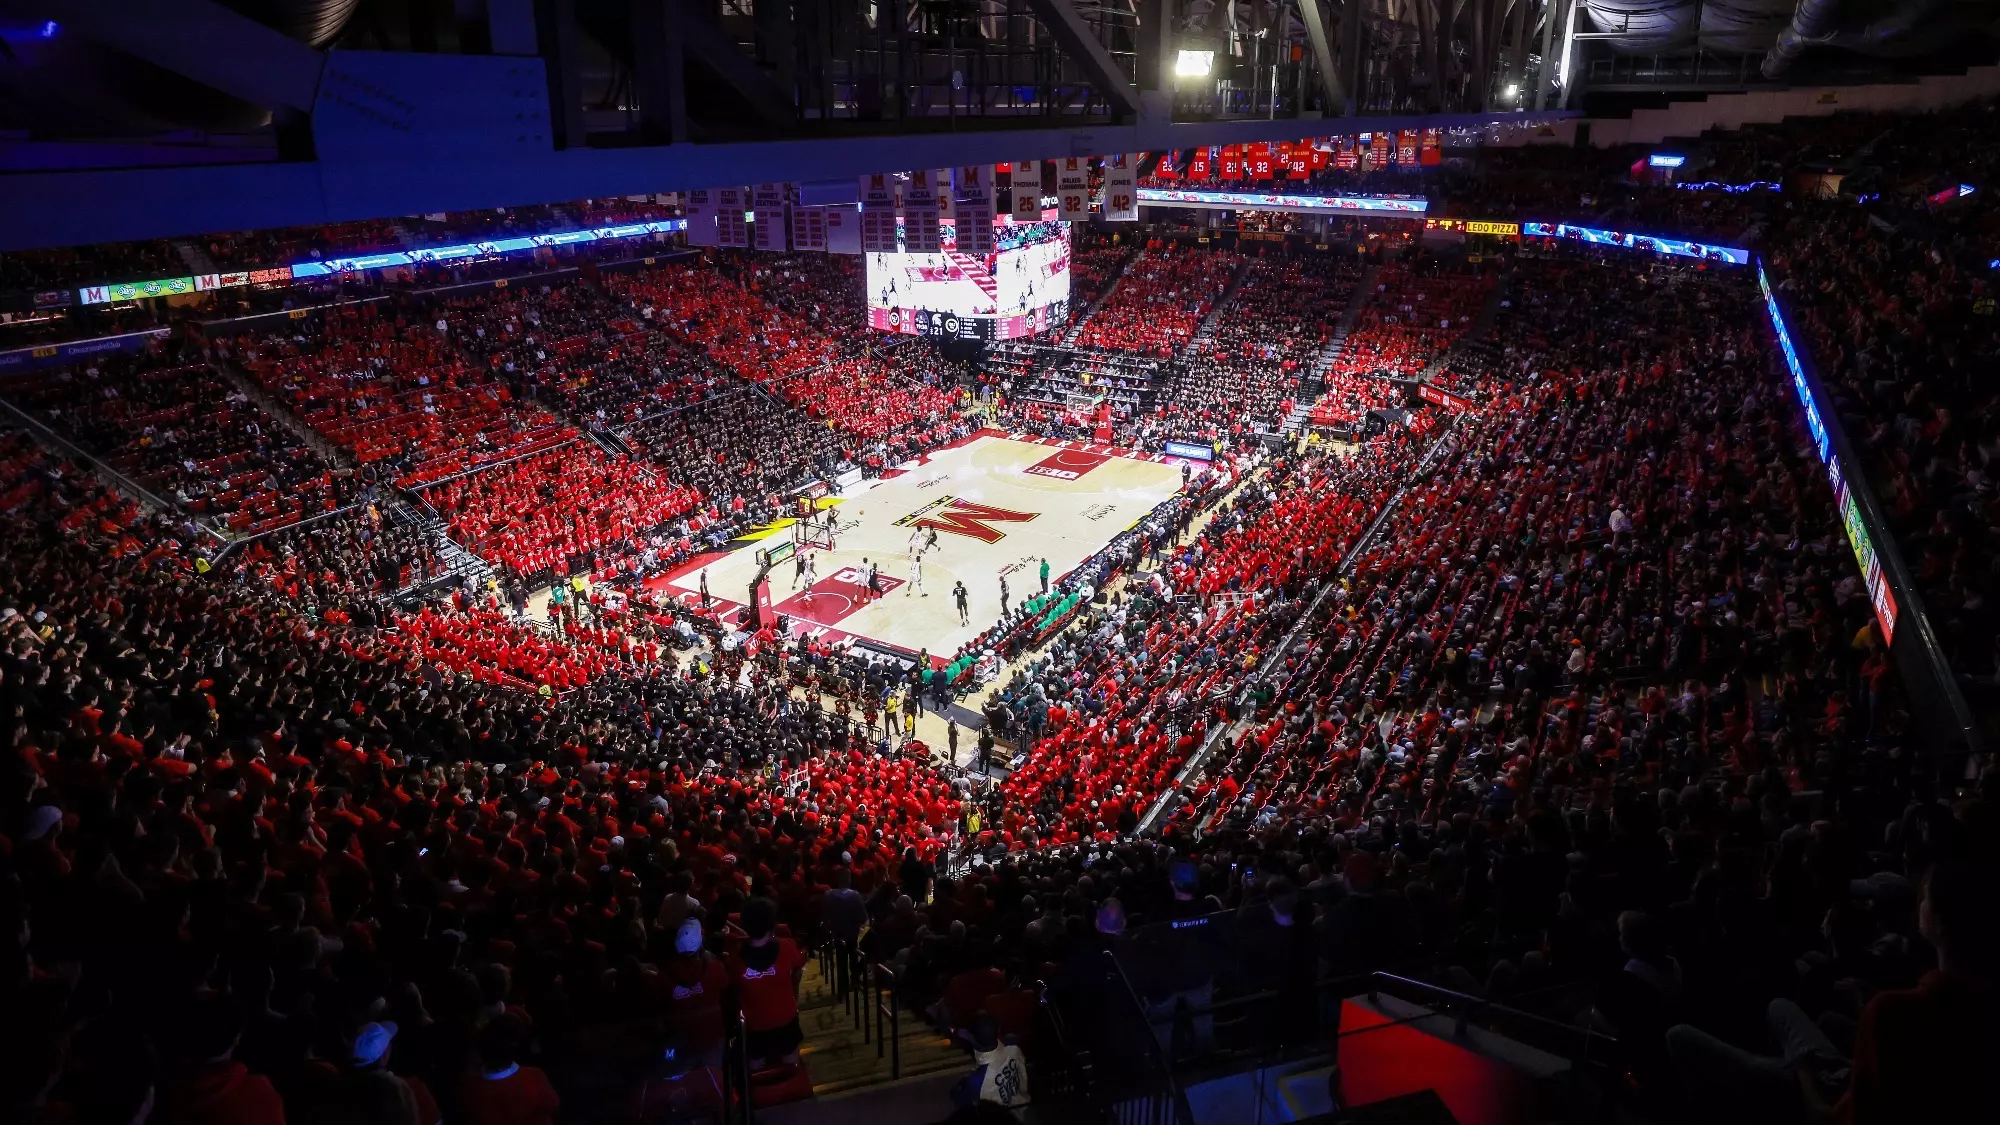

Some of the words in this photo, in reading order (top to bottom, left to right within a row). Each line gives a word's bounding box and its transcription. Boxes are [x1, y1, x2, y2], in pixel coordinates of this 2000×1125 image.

[1313, 153, 1319, 164] 6
[1194, 161, 1205, 172] 15
[1256, 162, 1268, 173] 32
[1292, 161, 1305, 172] 42
[964, 167, 978, 185] M
[910, 191, 930, 199] NCAA
[1019, 196, 1034, 212] 25
[1064, 196, 1081, 212] 32
[1113, 195, 1130, 211] 42
[1467, 223, 1489, 232] LEDO
[1491, 224, 1517, 233] PIZZA
[201, 275, 215, 289] M
[87, 287, 103, 301] M
[902, 310, 910, 321] M
[902, 324, 910, 332] 23
[934, 327, 943, 335] 21
[905, 497, 1044, 545] M
